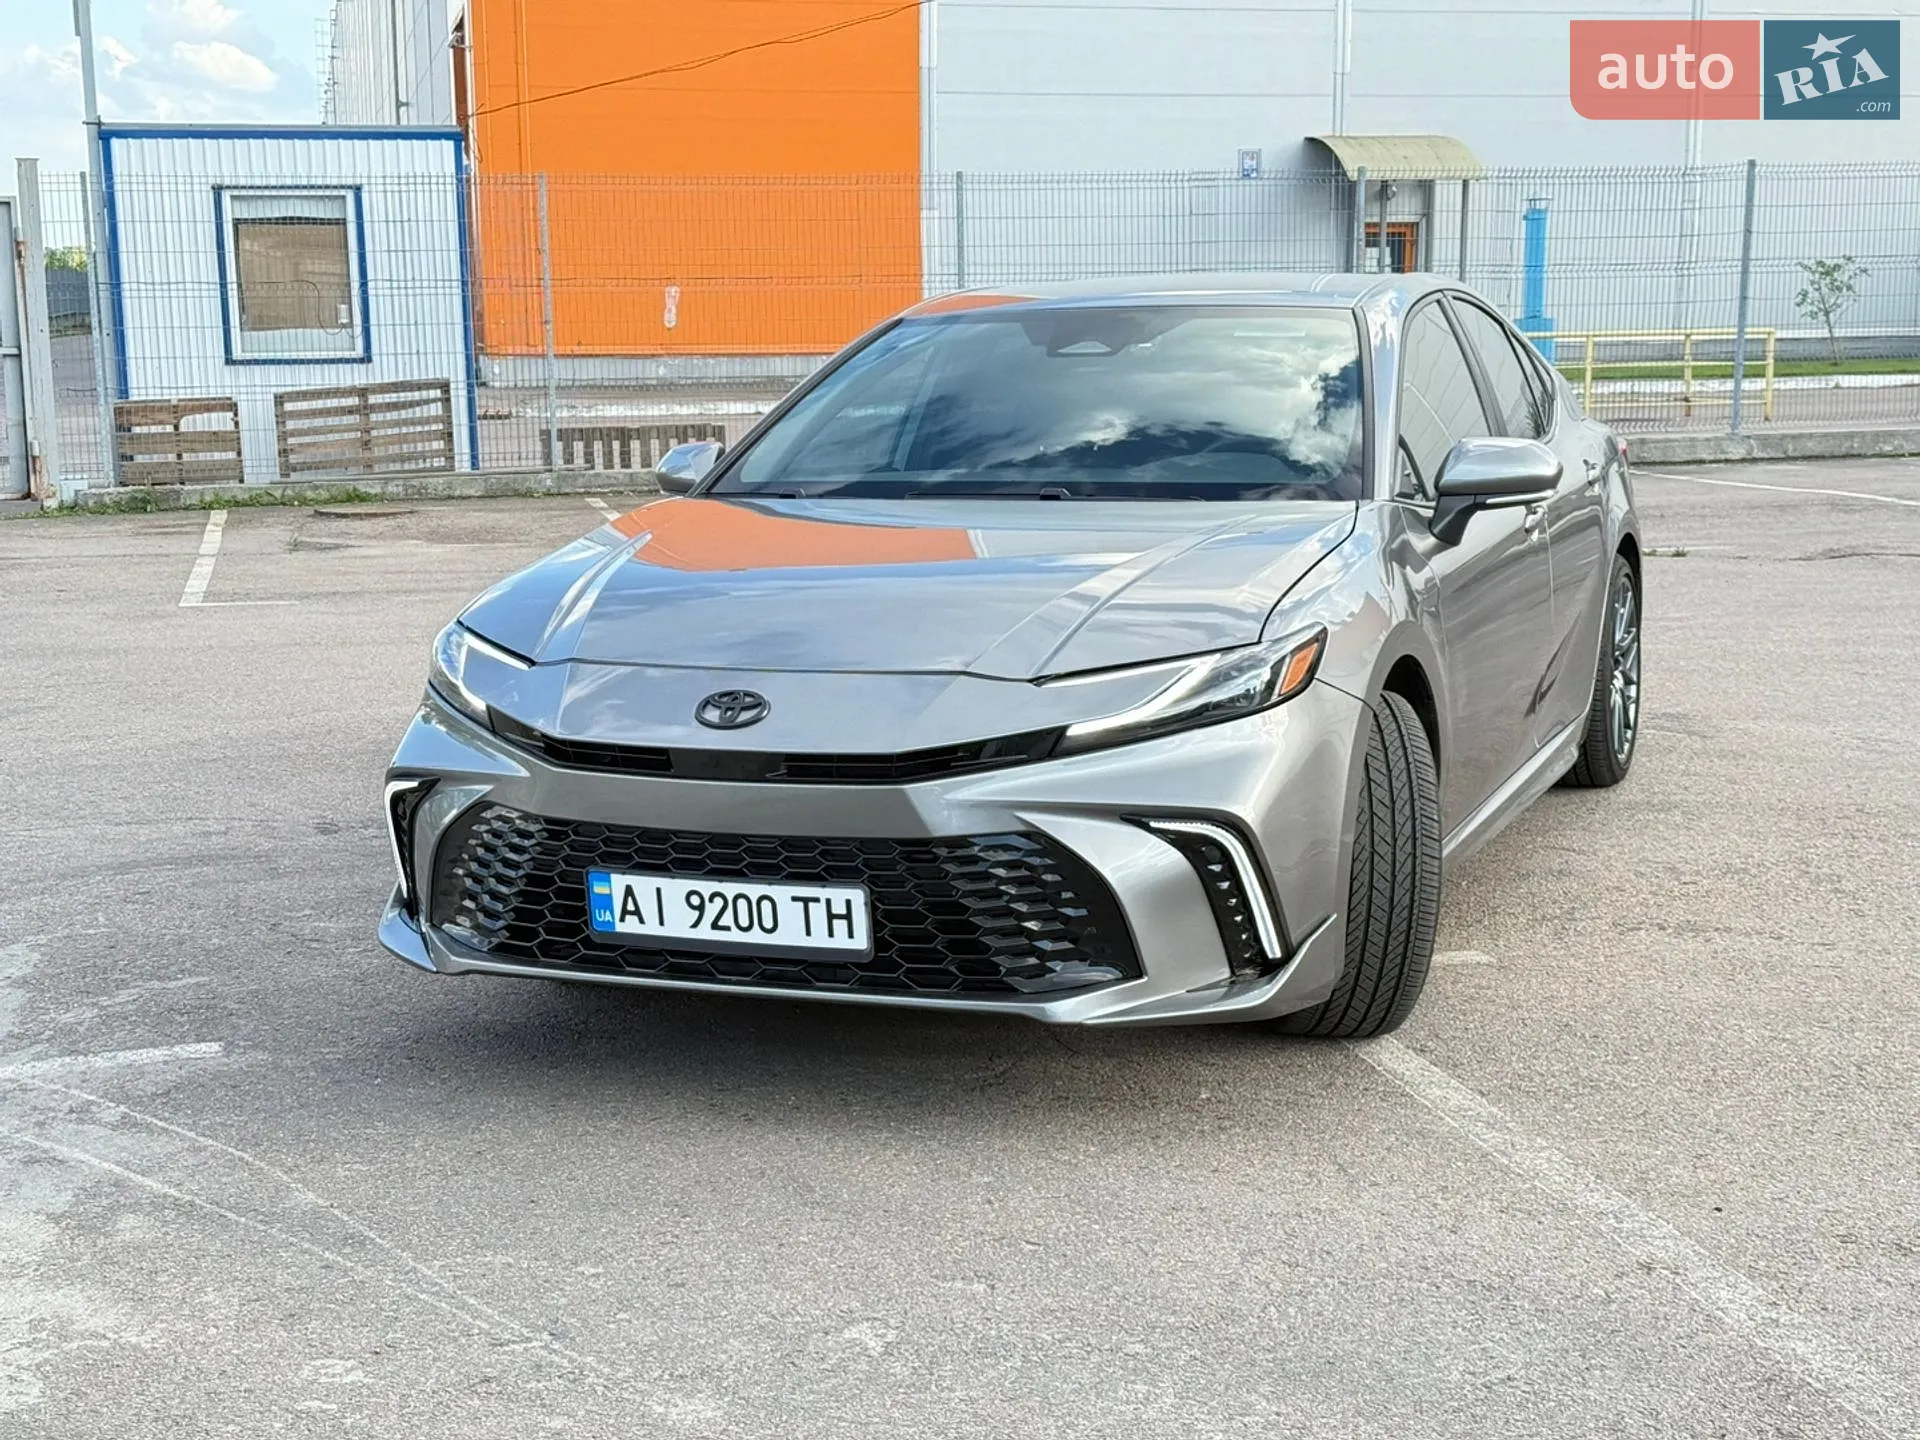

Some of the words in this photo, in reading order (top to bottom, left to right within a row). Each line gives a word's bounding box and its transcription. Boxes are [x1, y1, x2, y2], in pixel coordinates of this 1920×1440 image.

[595, 909, 614, 922] UA
[619, 884, 665, 927] AI
[684, 889, 779, 934] 9200
[791, 895, 855, 939] TH
